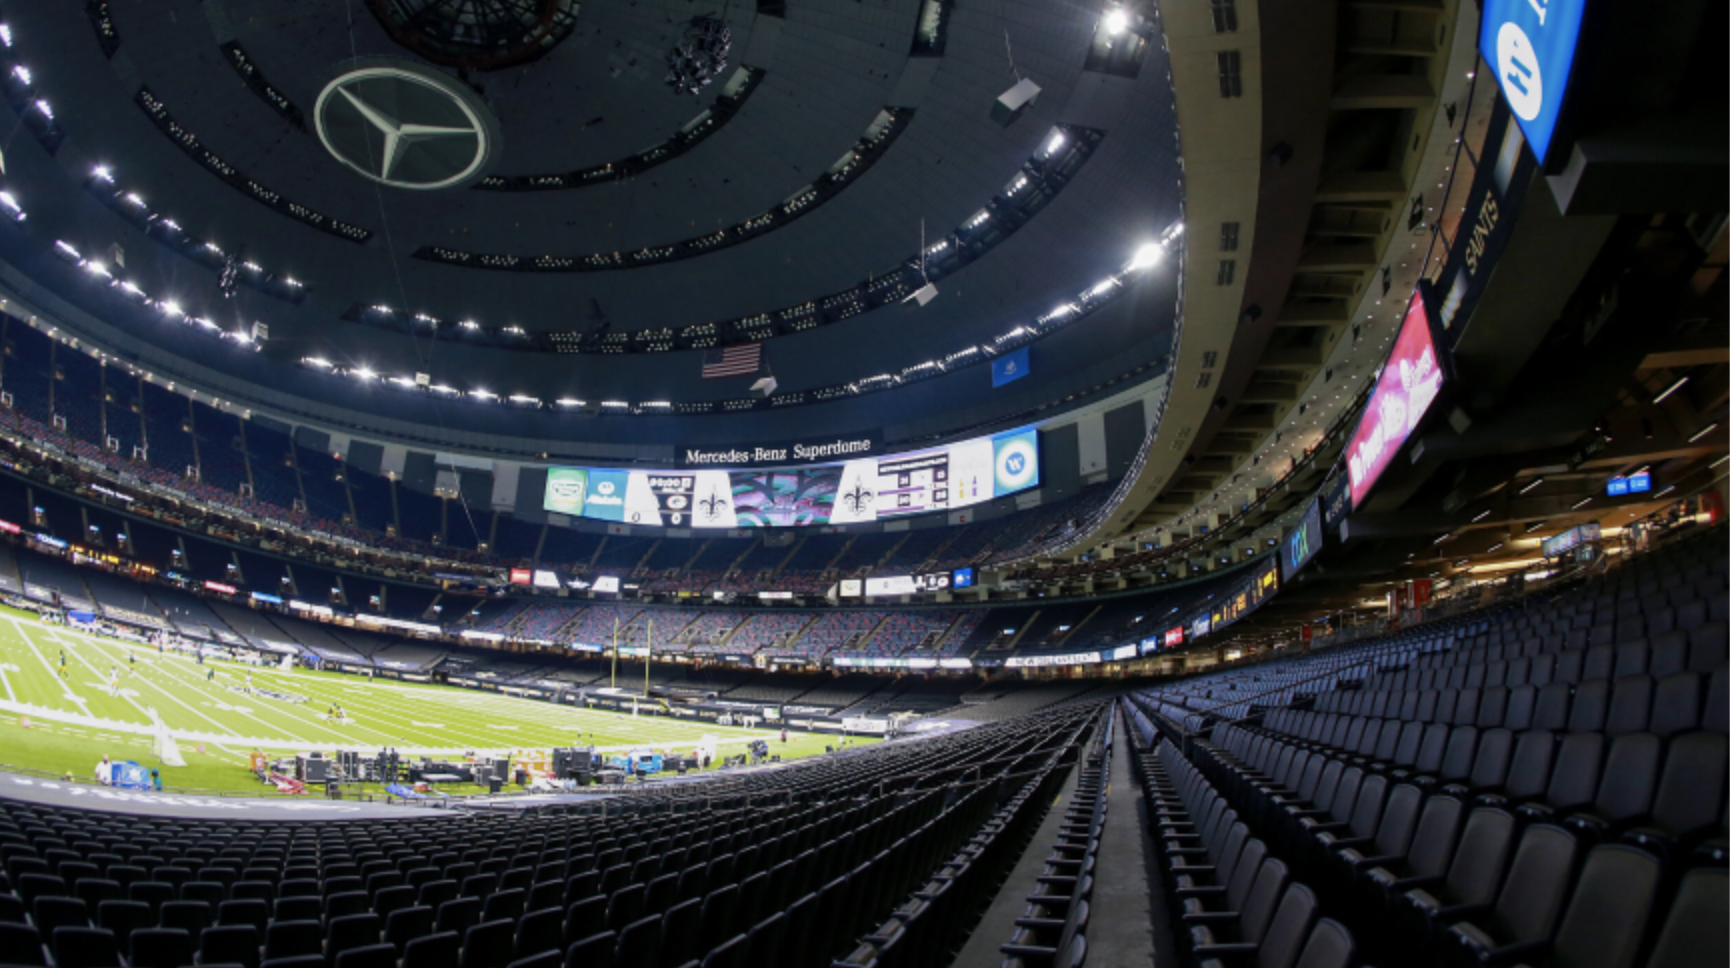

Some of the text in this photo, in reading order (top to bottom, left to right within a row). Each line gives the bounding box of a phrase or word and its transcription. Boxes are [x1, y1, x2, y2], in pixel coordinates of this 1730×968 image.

[1465, 190, 1498, 275] SAINTS
[685, 439, 871, 464] Mercedes-Benz Superdome
[632, 511, 641, 523] 0
